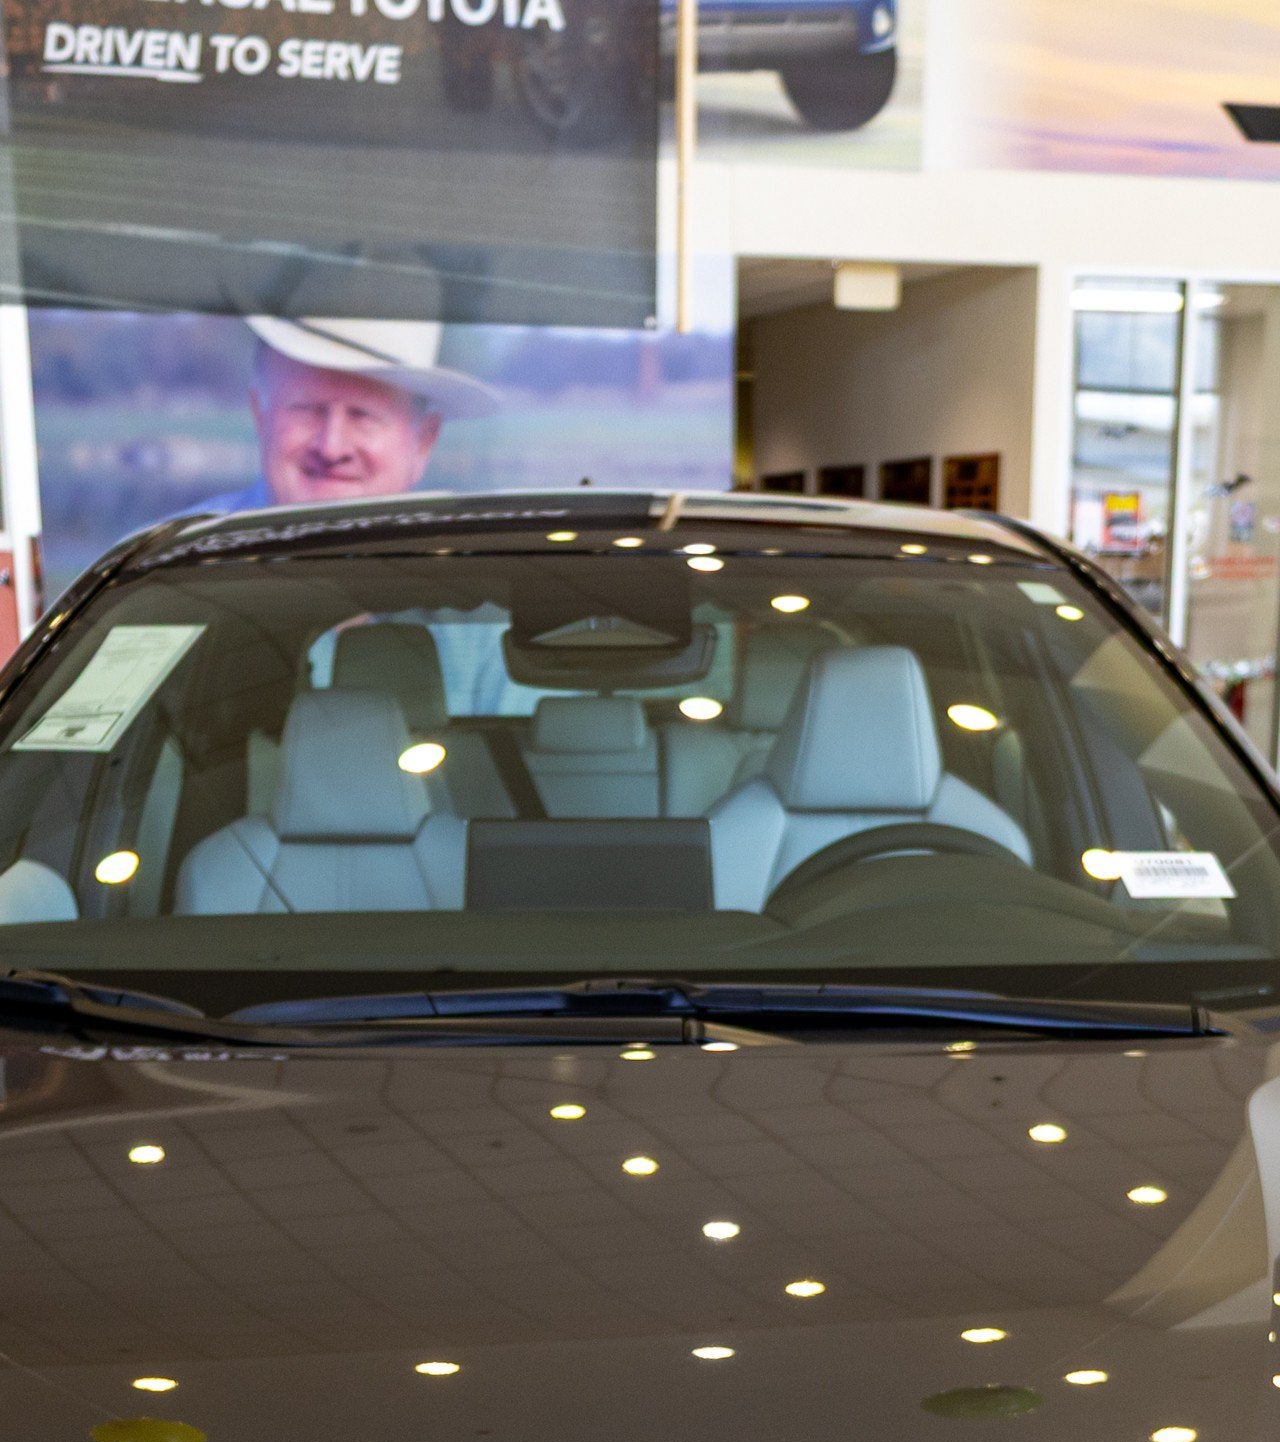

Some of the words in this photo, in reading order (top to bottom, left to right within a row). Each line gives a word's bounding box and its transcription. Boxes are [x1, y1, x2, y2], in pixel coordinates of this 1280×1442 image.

[43, 22, 202, 73] DRIVEN
[209, 34, 270, 76] TO
[277, 37, 402, 84] SERVE
